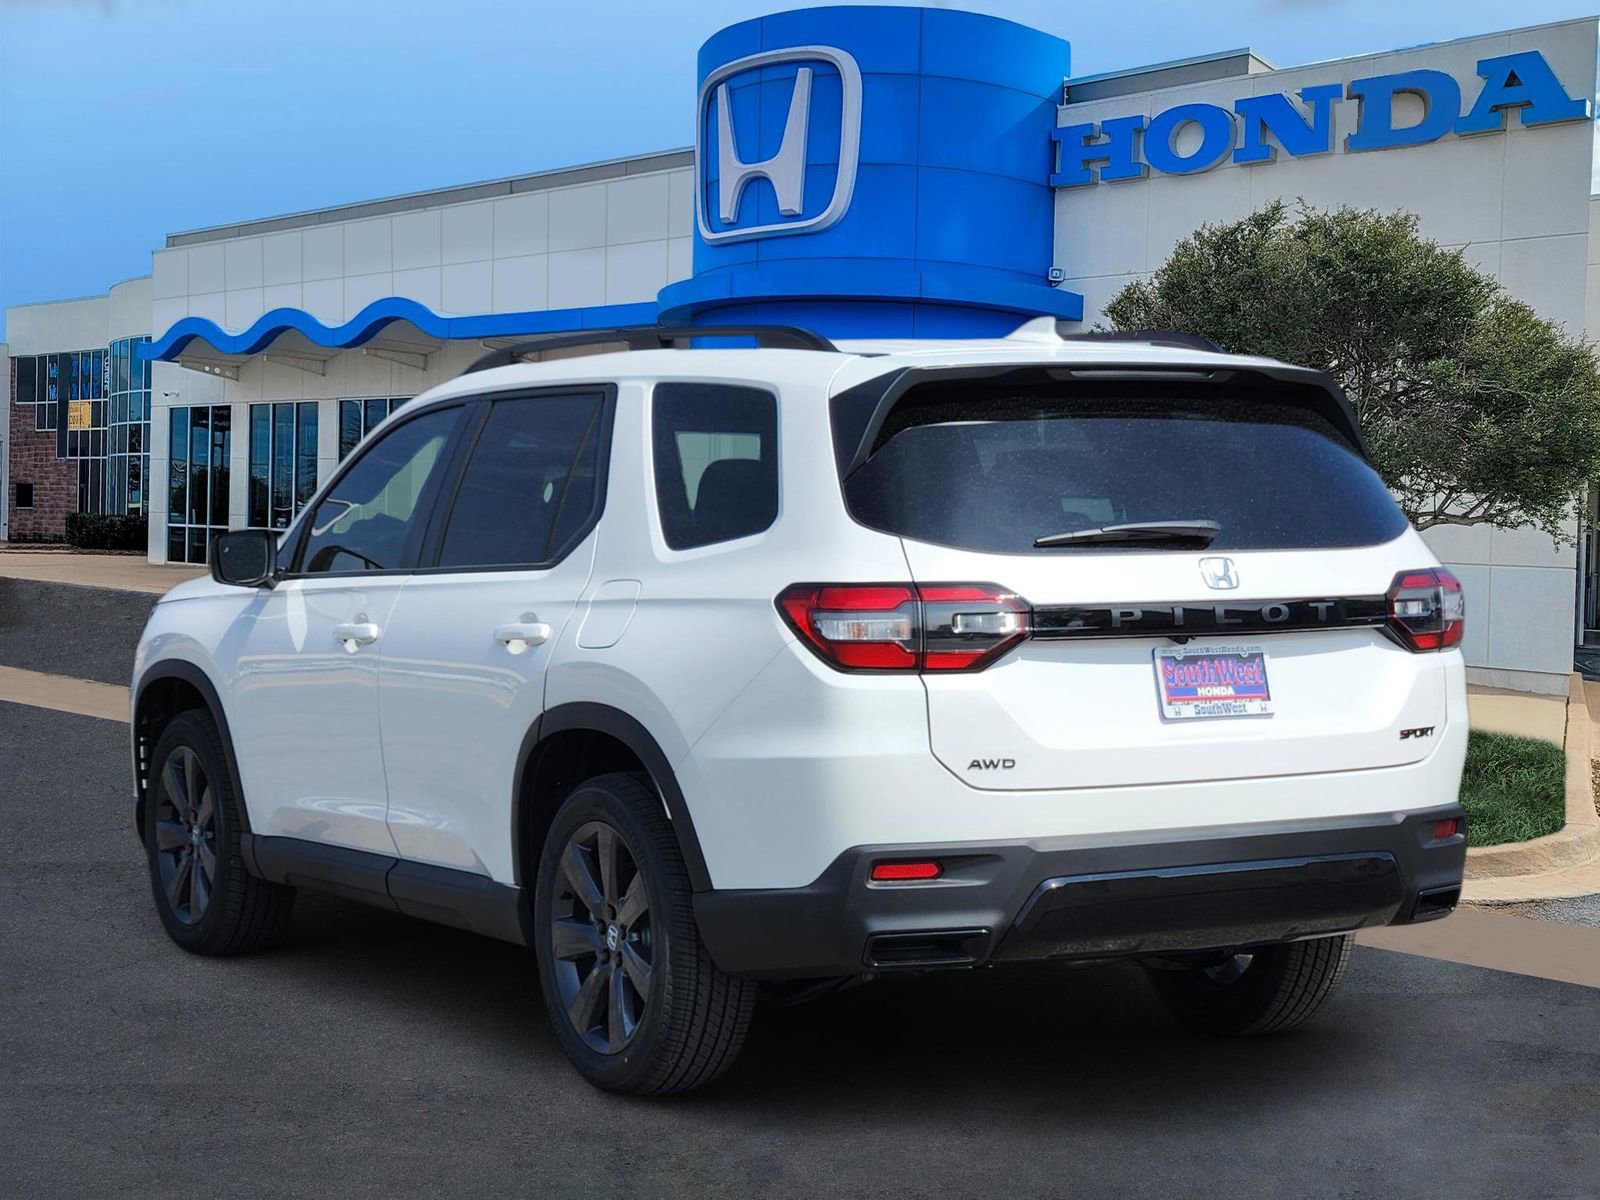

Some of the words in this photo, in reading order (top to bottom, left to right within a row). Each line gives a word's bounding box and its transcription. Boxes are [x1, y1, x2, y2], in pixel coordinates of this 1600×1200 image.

[1051, 50, 1591, 189] HONDA
[1110, 601, 1335, 628] PILOT
[1197, 686, 1235, 697] HONDA
[1194, 702, 1248, 715] SouthWest
[1399, 725, 1436, 741] SPORT
[966, 758, 1016, 771] AWD
